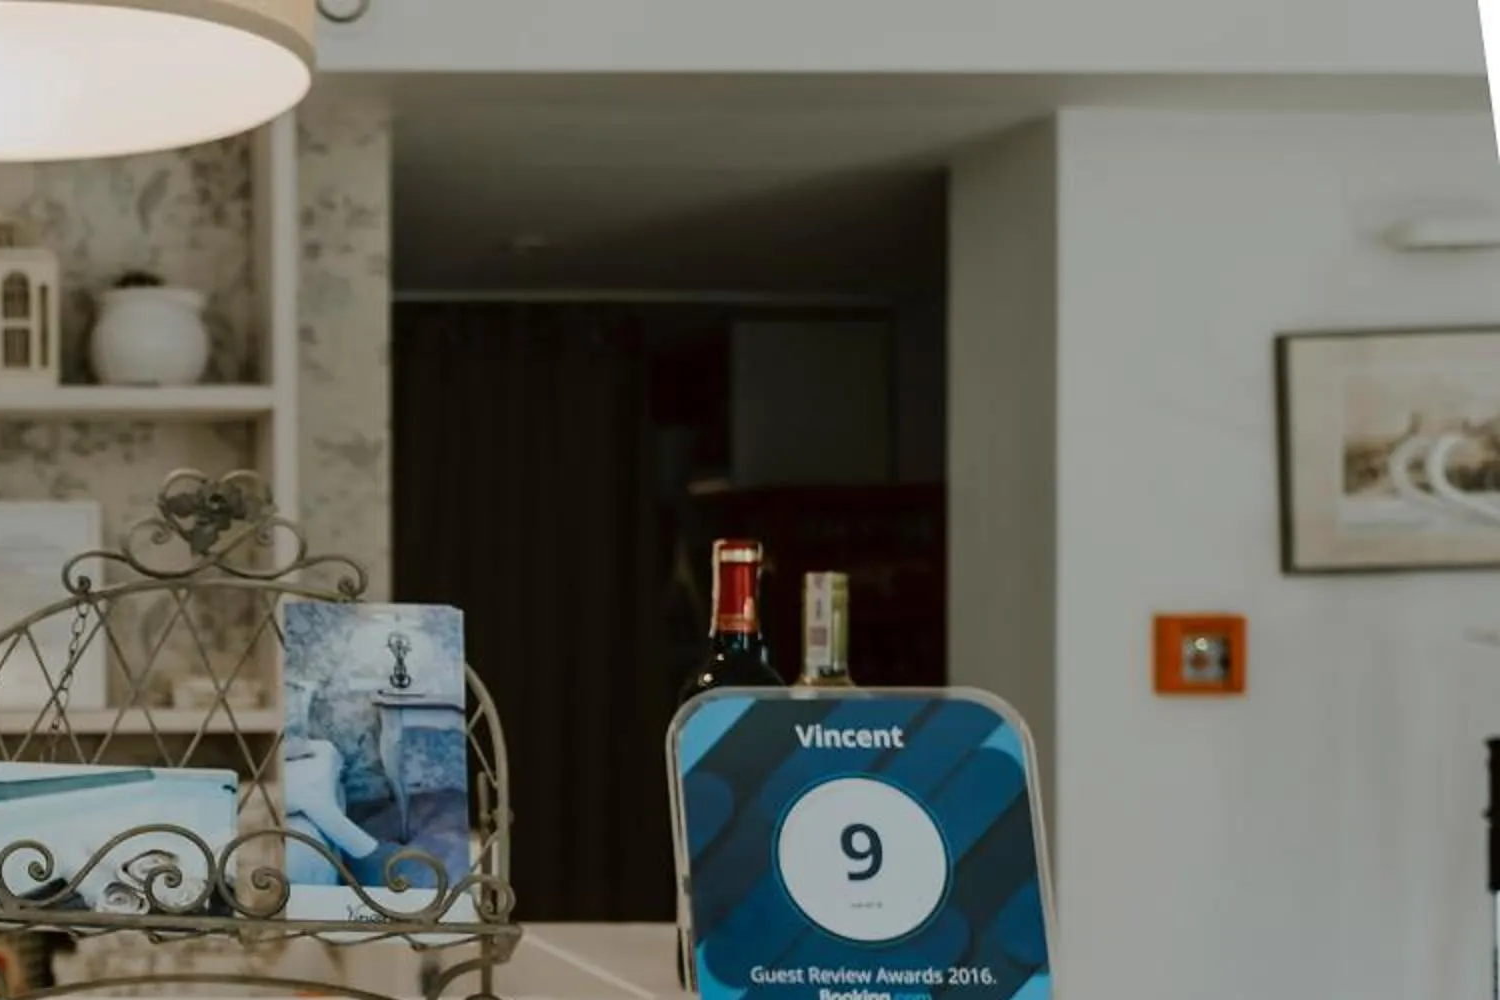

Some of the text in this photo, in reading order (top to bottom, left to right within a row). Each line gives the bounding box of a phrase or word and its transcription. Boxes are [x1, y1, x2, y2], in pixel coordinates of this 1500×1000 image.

[795, 724, 904, 749] Vincent
[840, 822, 884, 882] 9
[750, 966, 998, 985] Guest Review Awards 2016.
